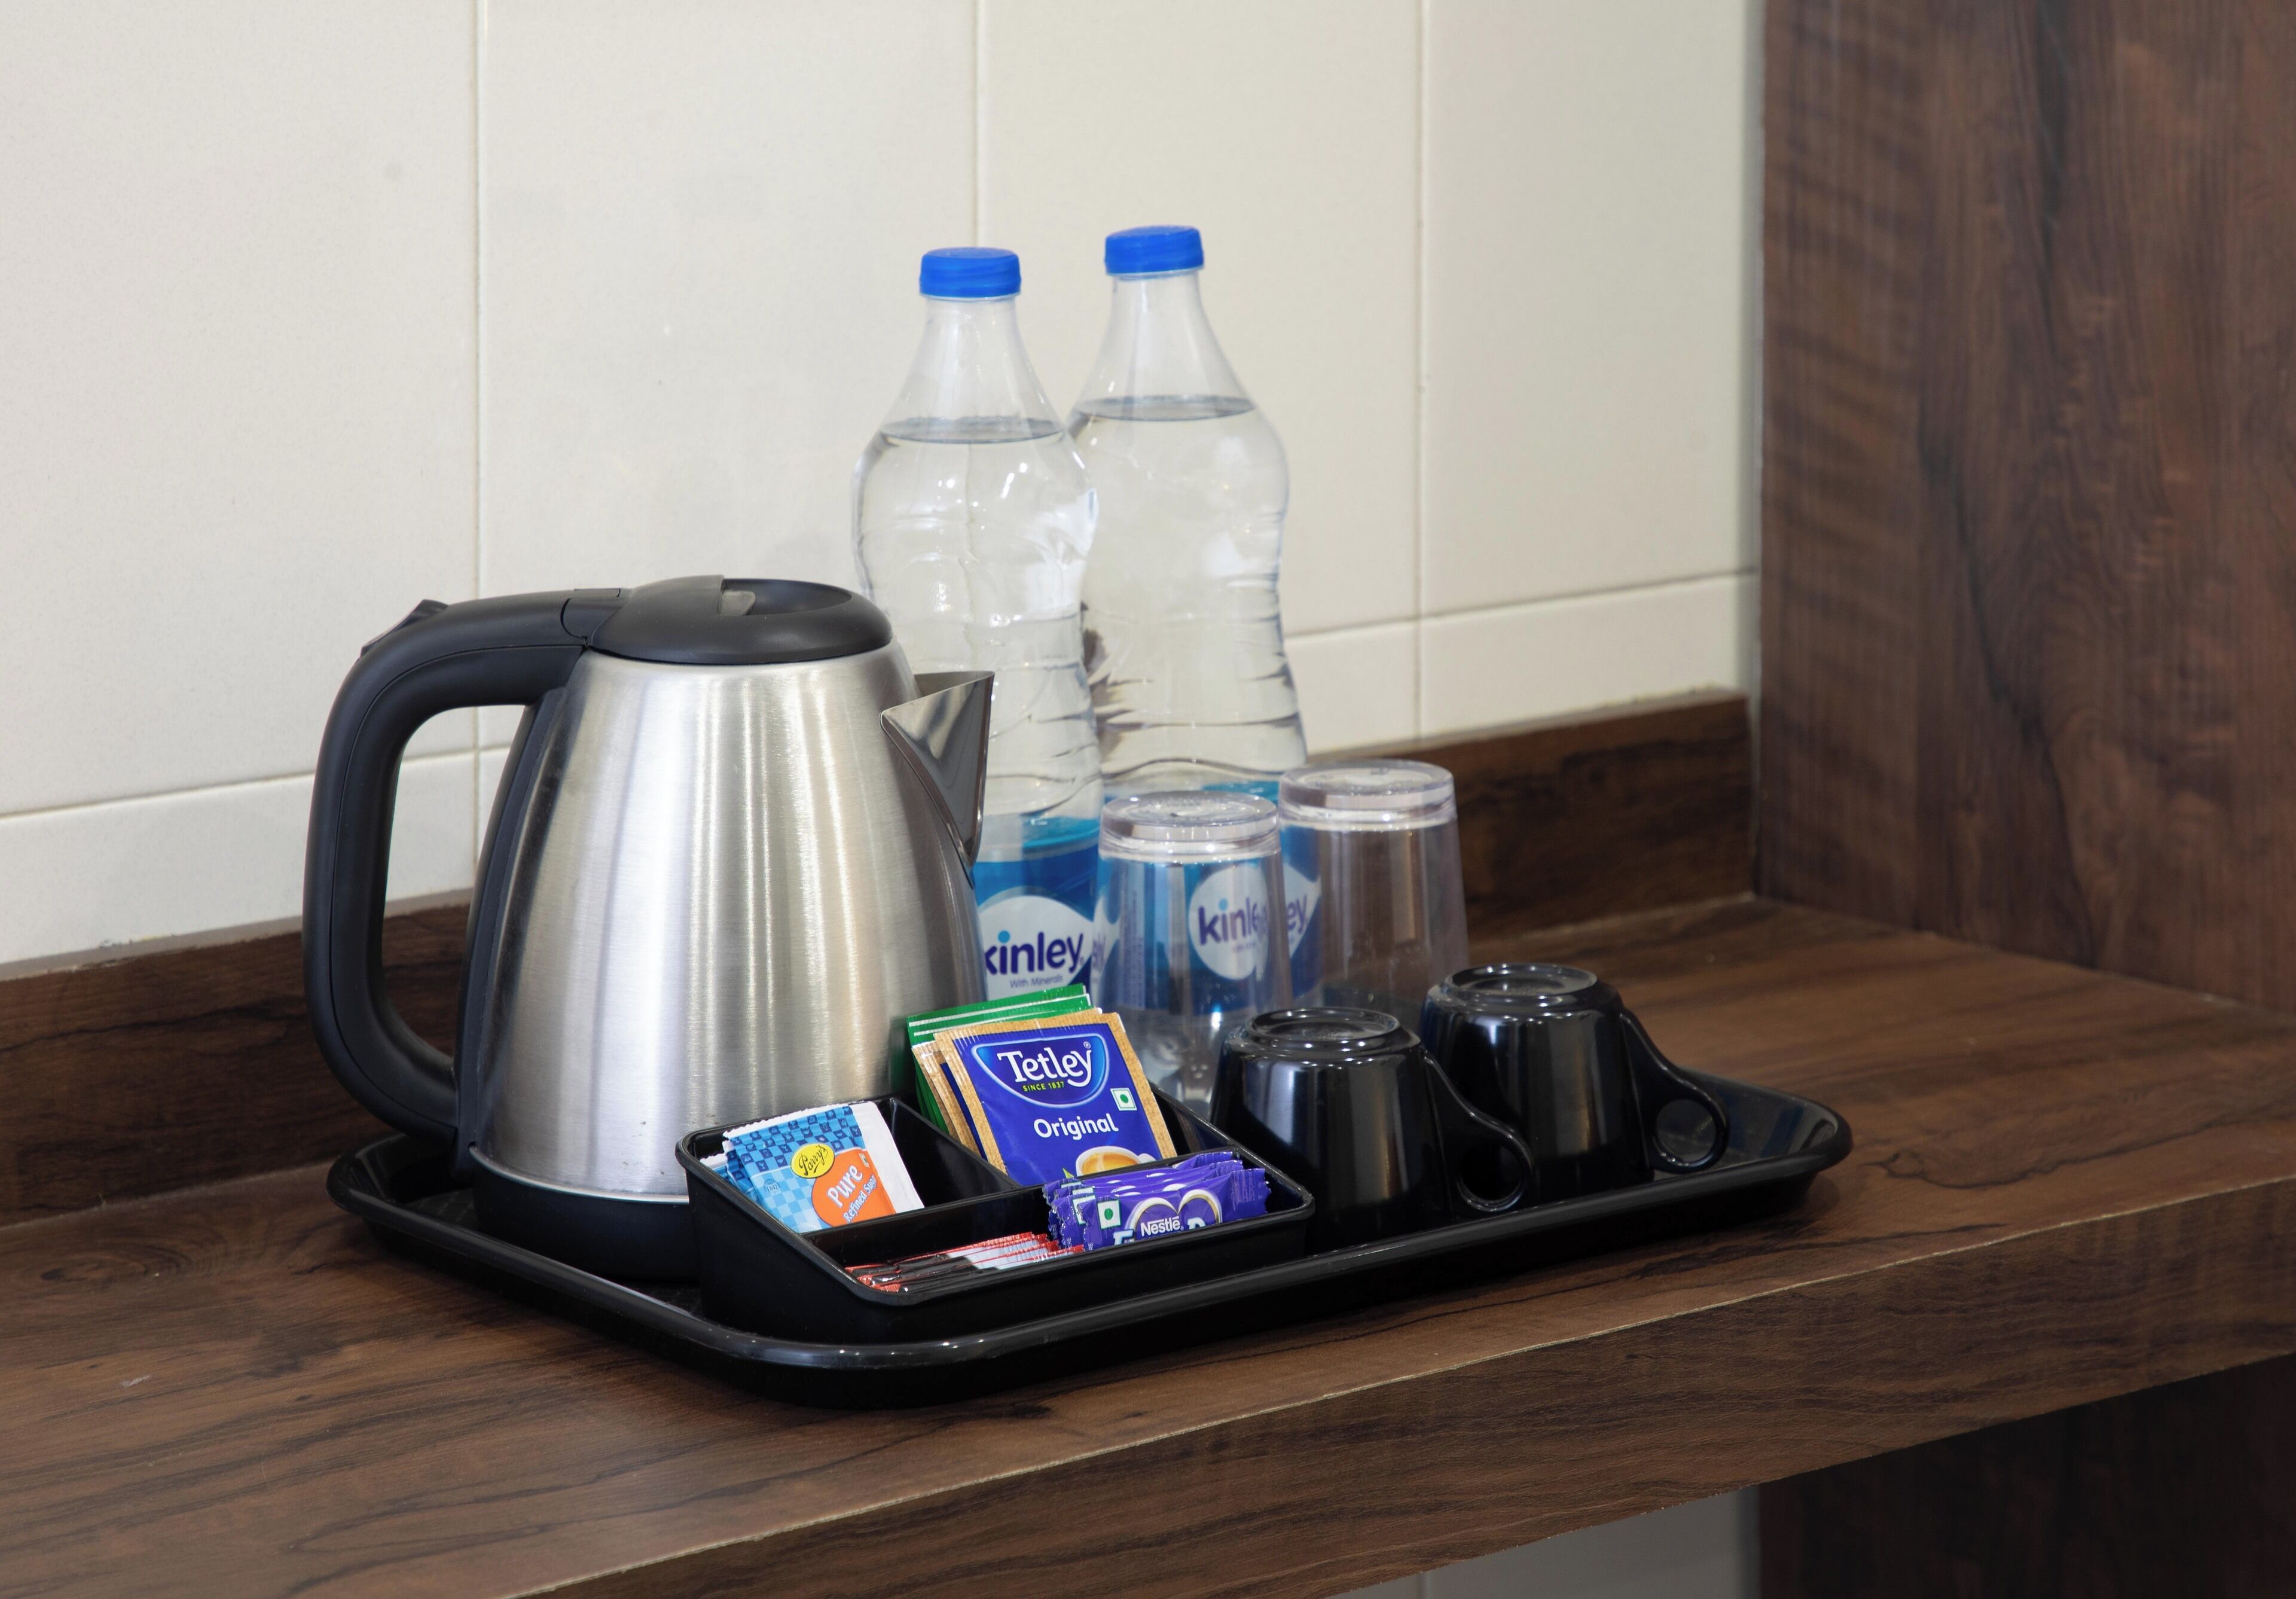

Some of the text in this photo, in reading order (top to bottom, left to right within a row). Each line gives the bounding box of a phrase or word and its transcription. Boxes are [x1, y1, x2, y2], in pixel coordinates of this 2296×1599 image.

[997, 1047, 1092, 1087] Tetley
[1022, 1081, 1064, 1092] SINCE 1837
[1033, 1113, 1119, 1140] Original
[798, 1145, 828, 1176] Parry's
[826, 1165, 863, 1209] Pure
[843, 1190, 868, 1223] Refined
